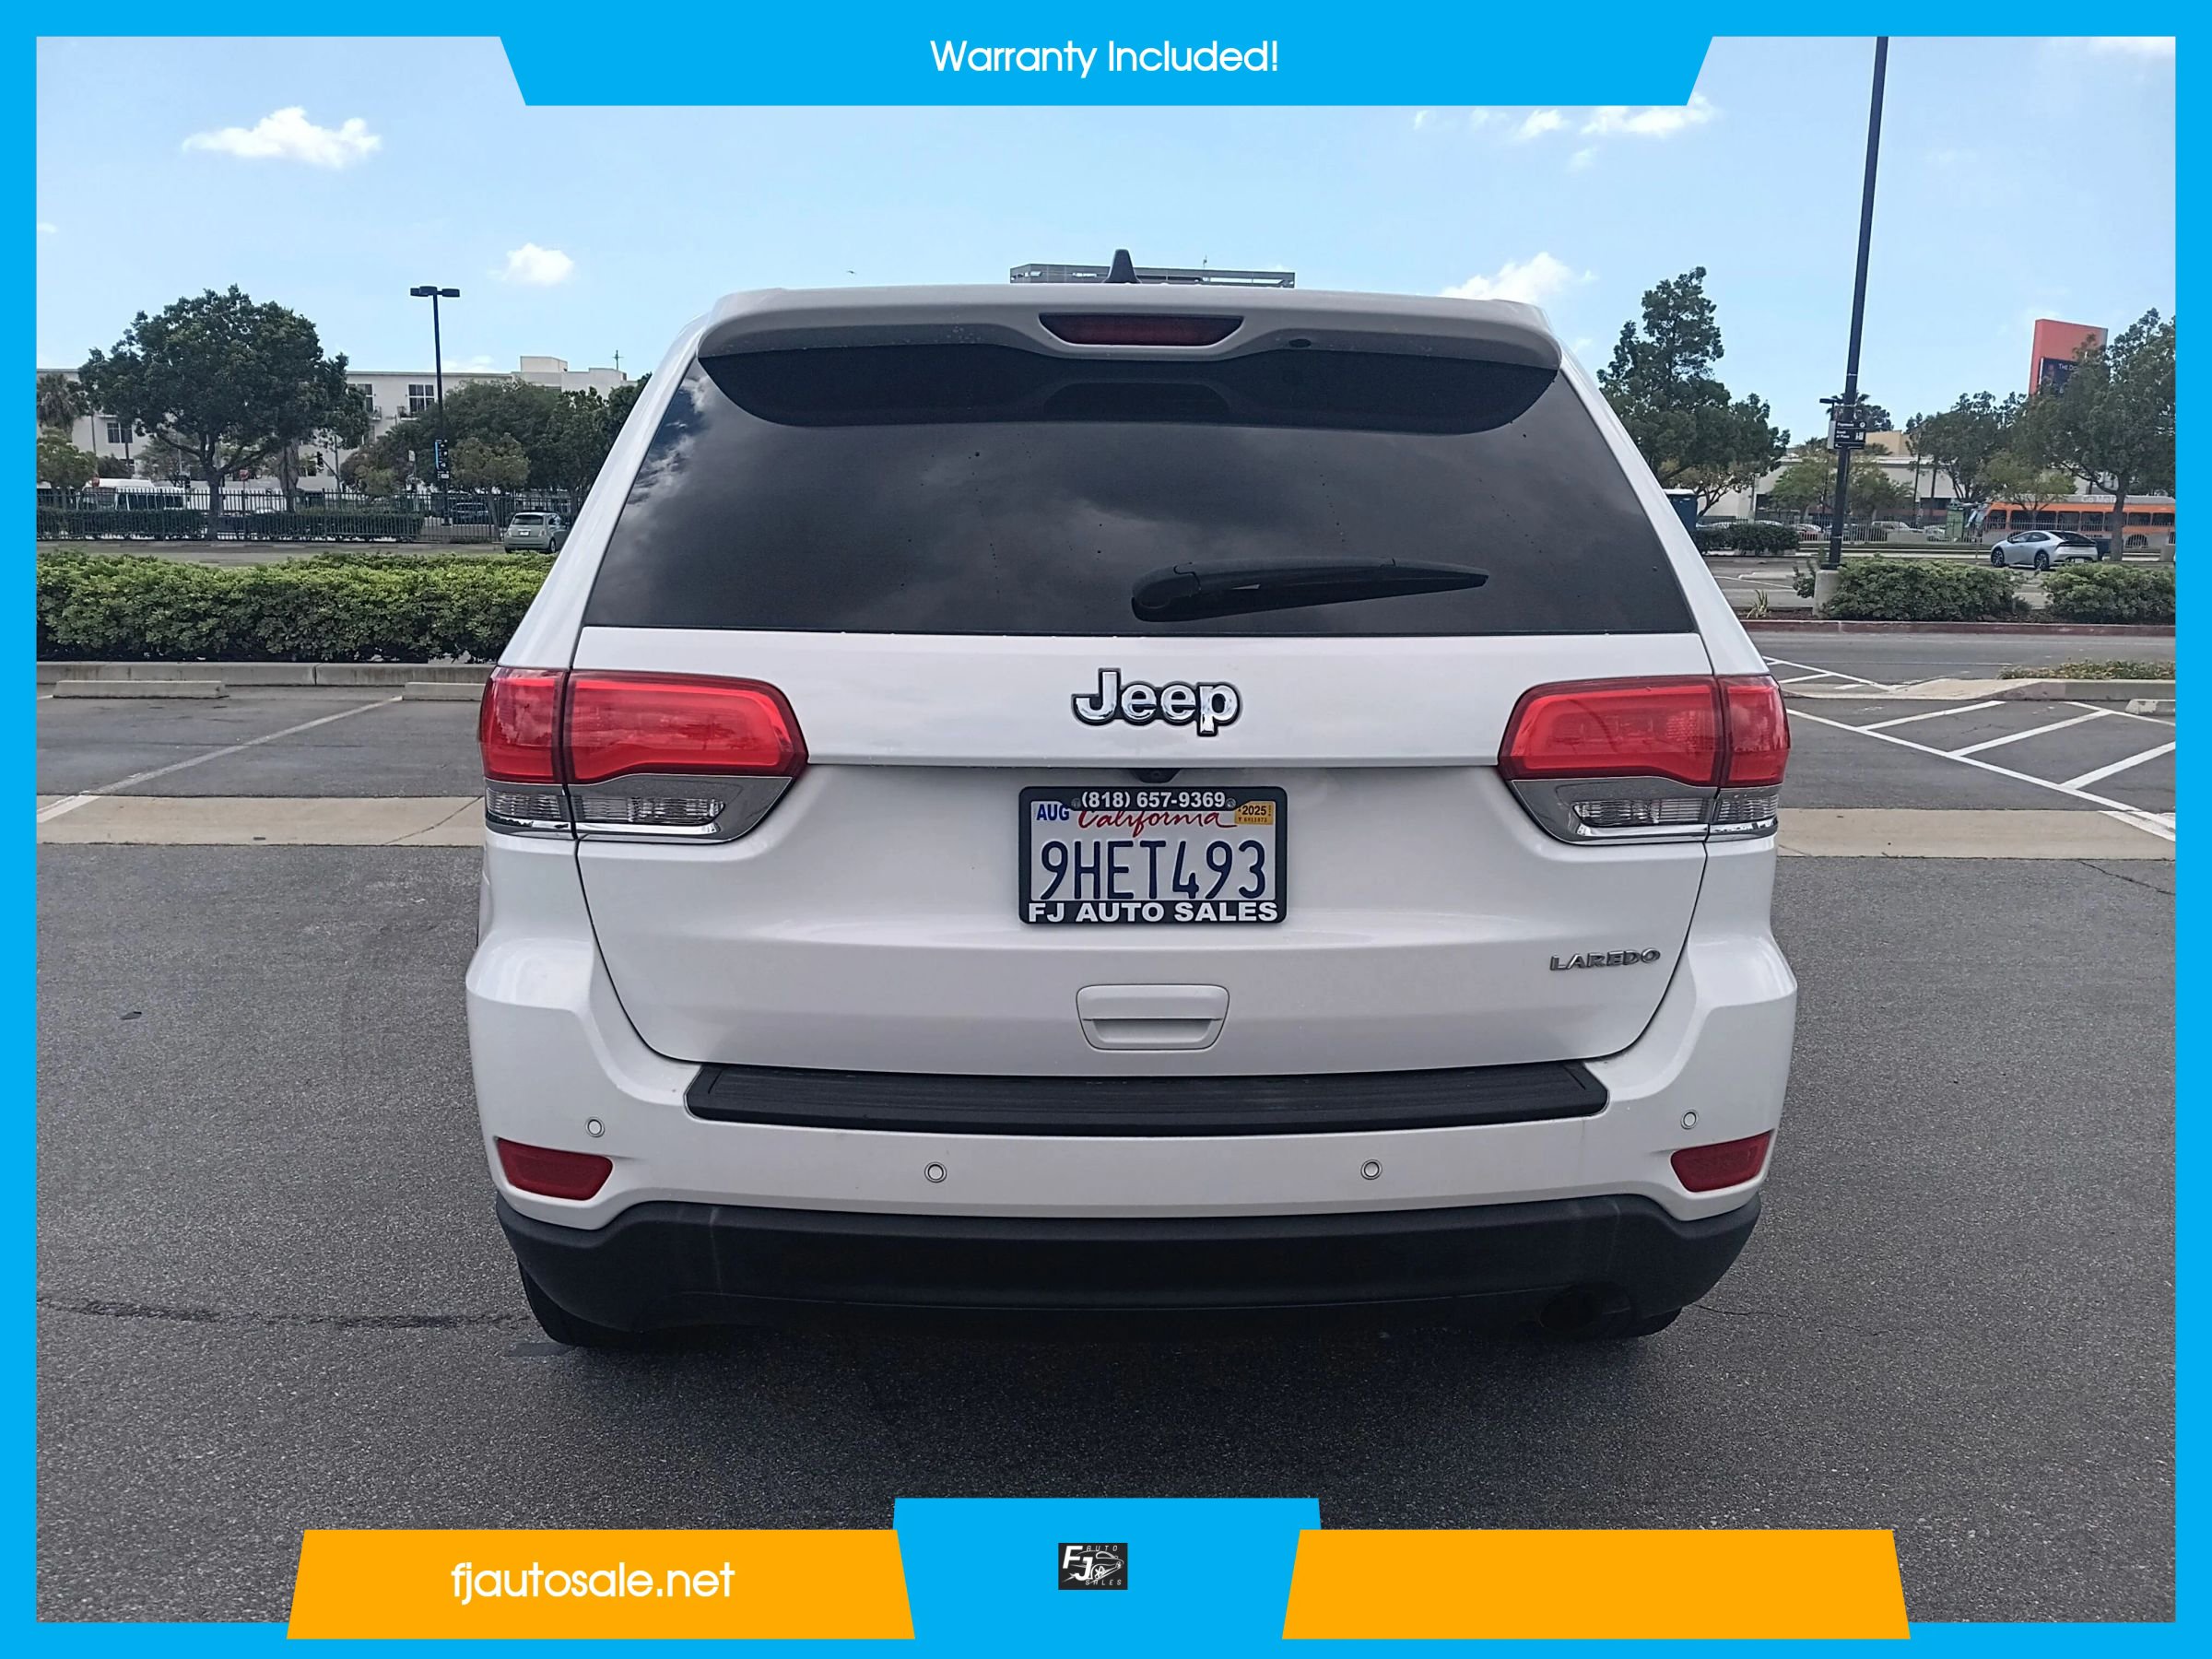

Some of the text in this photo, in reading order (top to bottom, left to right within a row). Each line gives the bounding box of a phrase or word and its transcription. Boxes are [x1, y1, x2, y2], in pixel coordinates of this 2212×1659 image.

[1071, 667, 1242, 737] Jeep
[1081, 791, 1226, 808] (818) 657-9369
[1036, 803, 1069, 821] AUG
[1241, 805, 1267, 816] 2025
[1040, 840, 1266, 900] 9HET493
[1029, 902, 1278, 922] FJ AUTO SALES
[1549, 947, 1661, 971] LAREDO
